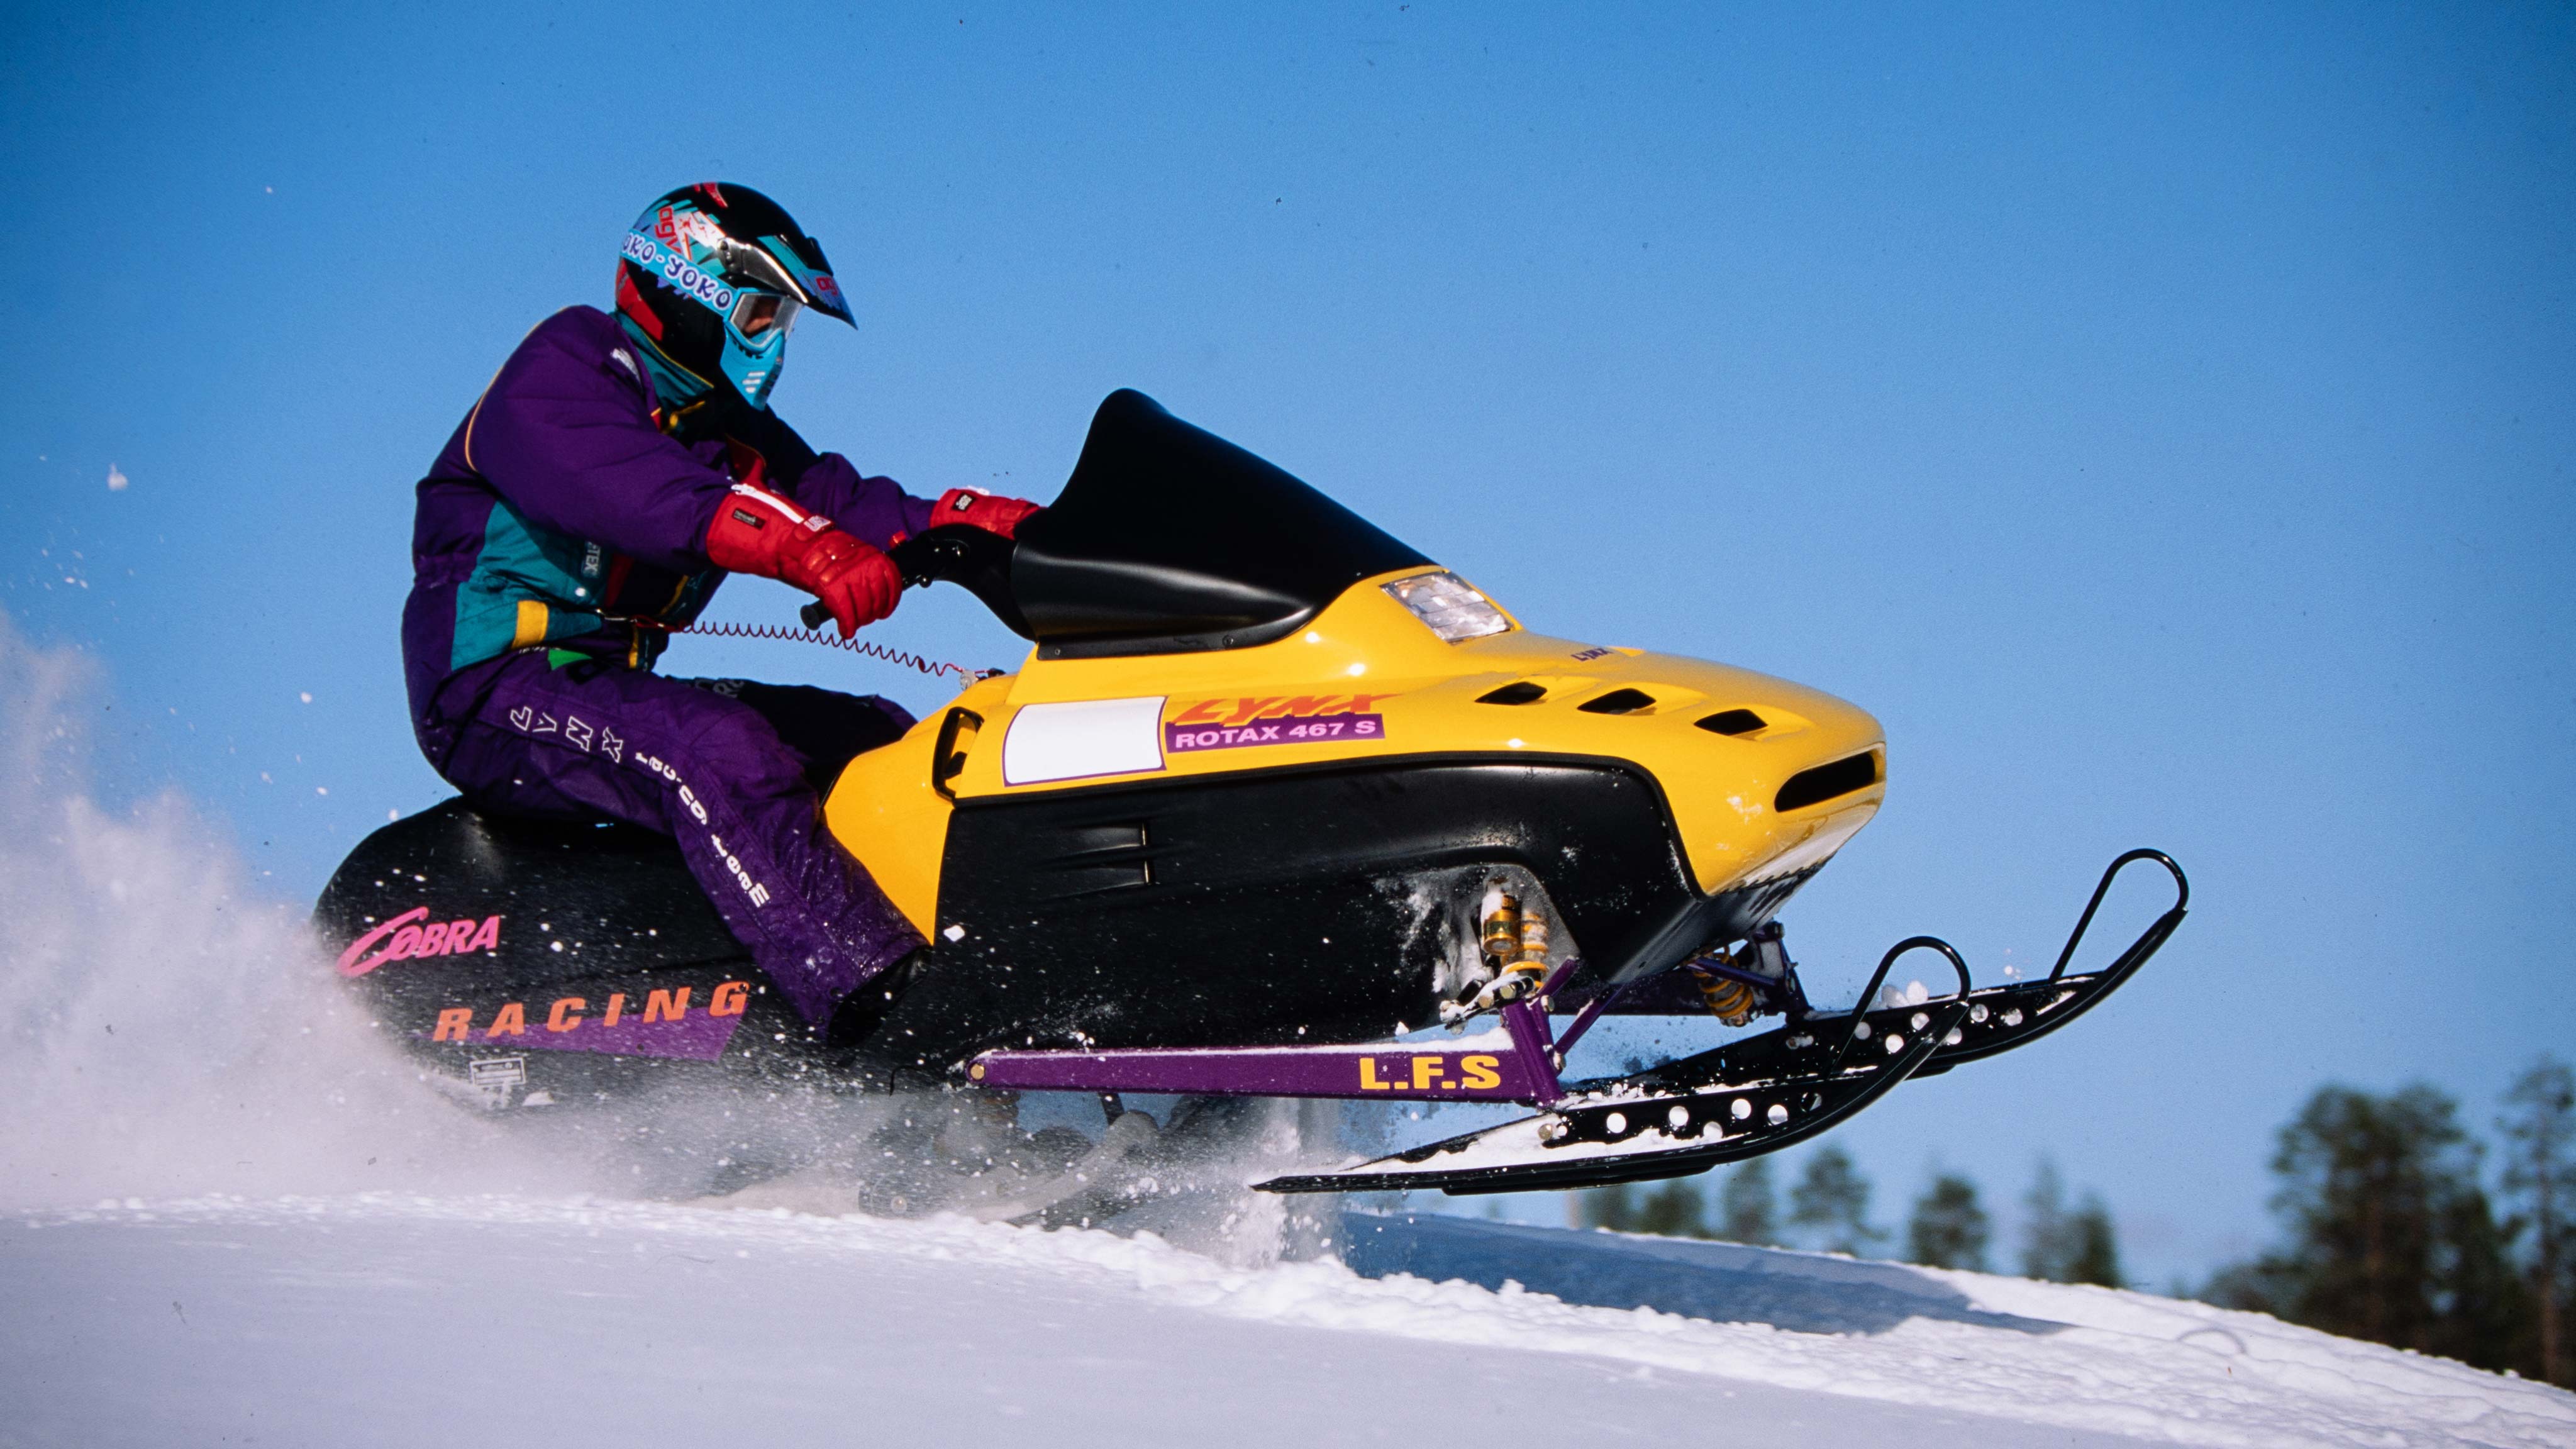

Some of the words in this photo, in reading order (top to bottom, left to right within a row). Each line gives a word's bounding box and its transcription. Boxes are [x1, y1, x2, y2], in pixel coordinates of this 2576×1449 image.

[1169, 693, 1406, 727] LYNX
[1175, 725, 1280, 748] ROTAX
[1289, 723, 1345, 738] 467
[1353, 720, 1376, 735] S
[510, 706, 623, 763] LYNX
[635, 752, 707, 825] racing
[711, 834, 770, 908] team
[336, 906, 500, 977] COBRA
[432, 980, 750, 1041] RACING
[1359, 1055, 1501, 1090] L.F.S
